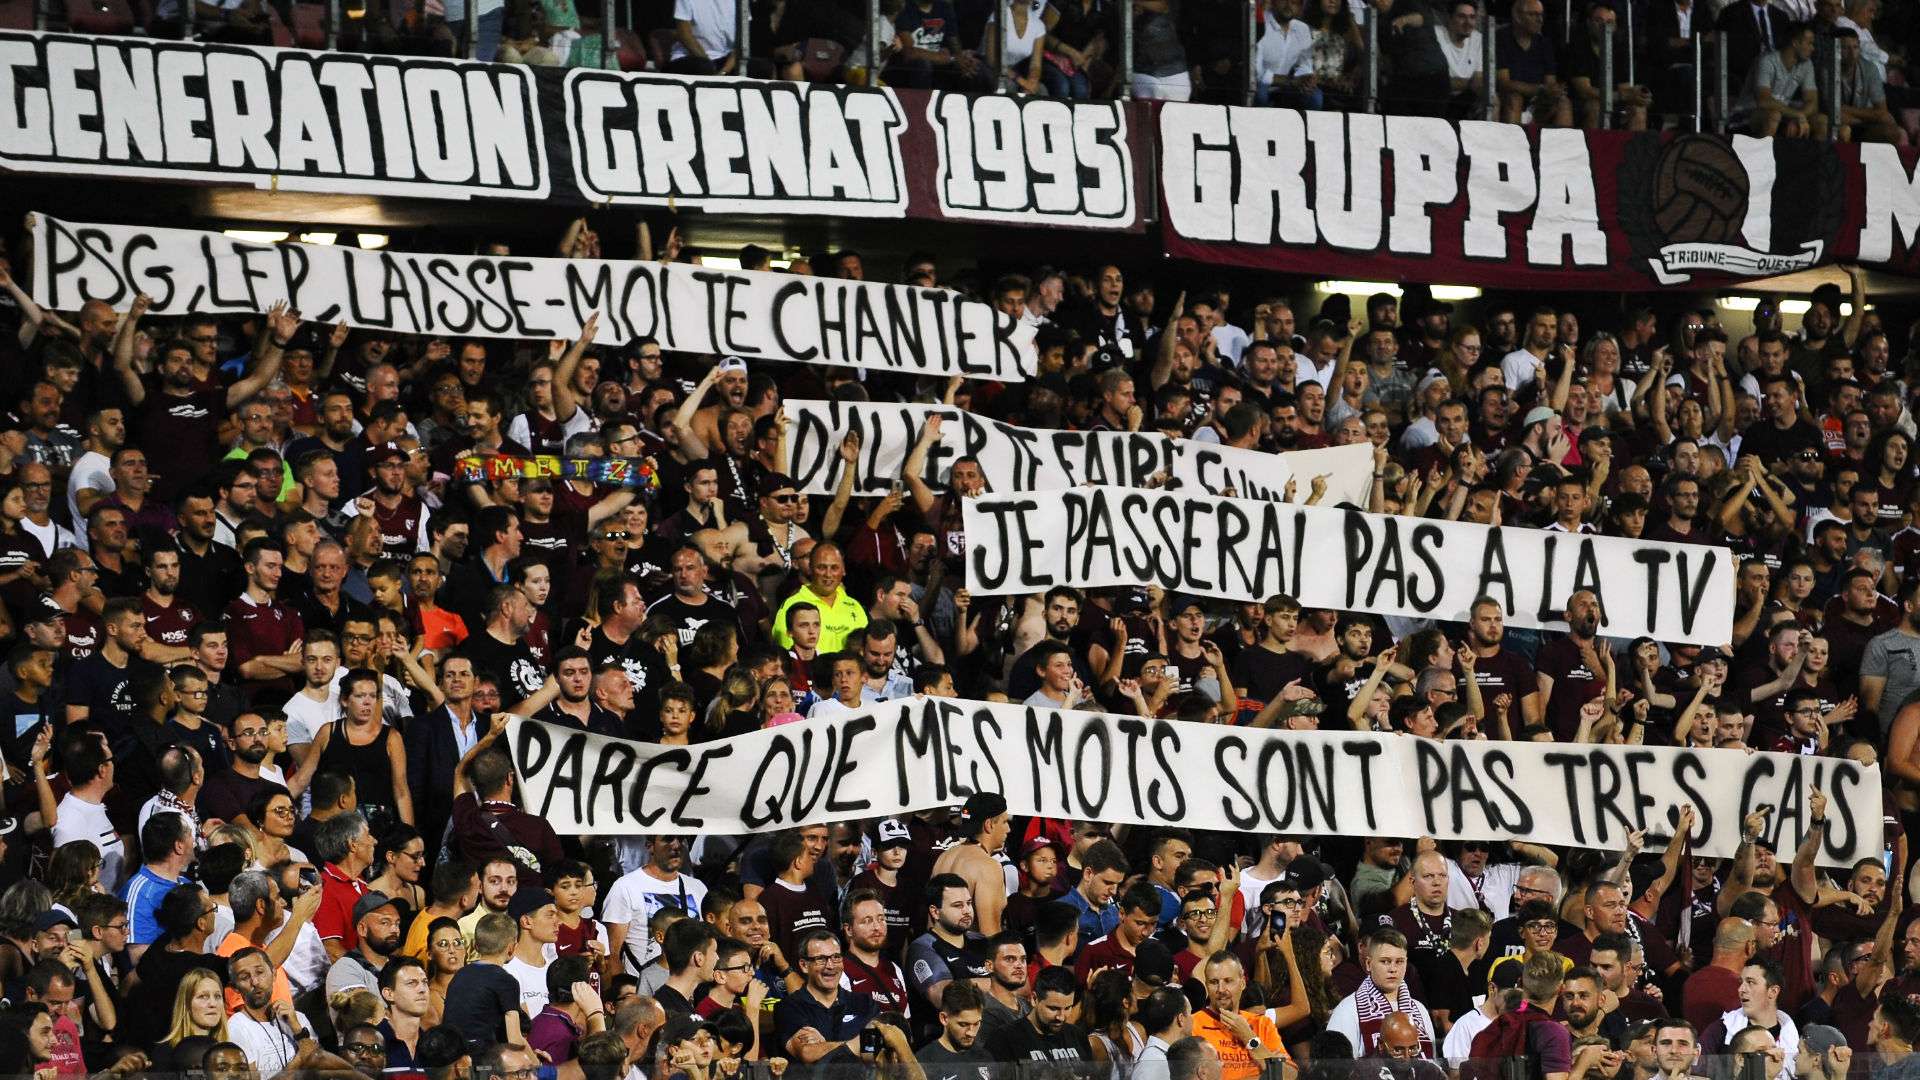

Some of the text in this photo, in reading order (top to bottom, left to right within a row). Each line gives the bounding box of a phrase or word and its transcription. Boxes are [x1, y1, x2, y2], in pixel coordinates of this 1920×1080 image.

[0, 39, 1125, 216] GENERATION GRENAT 1995
[1159, 101, 1608, 266] GRUPPA
[344, 249, 676, 348] LAISSE-MOI
[693, 271, 762, 355] TE
[772, 281, 1025, 380] CHANTER
[1756, 257, 1798, 271] OUEST
[494, 455, 628, 482] METZ
[790, 400, 994, 492] D'ALLER
[1051, 431, 1185, 492] FAIRE
[972, 488, 1718, 637] JE PASSERAI PAS A LA TV
[516, 715, 734, 828] PARCE
[740, 715, 877, 830] QUE
[895, 697, 1005, 808] MES
[1025, 709, 1188, 822] MOTS
[1214, 735, 1383, 832] SONT
[1416, 738, 1534, 836] PAS
[1544, 749, 1714, 850] TRES
